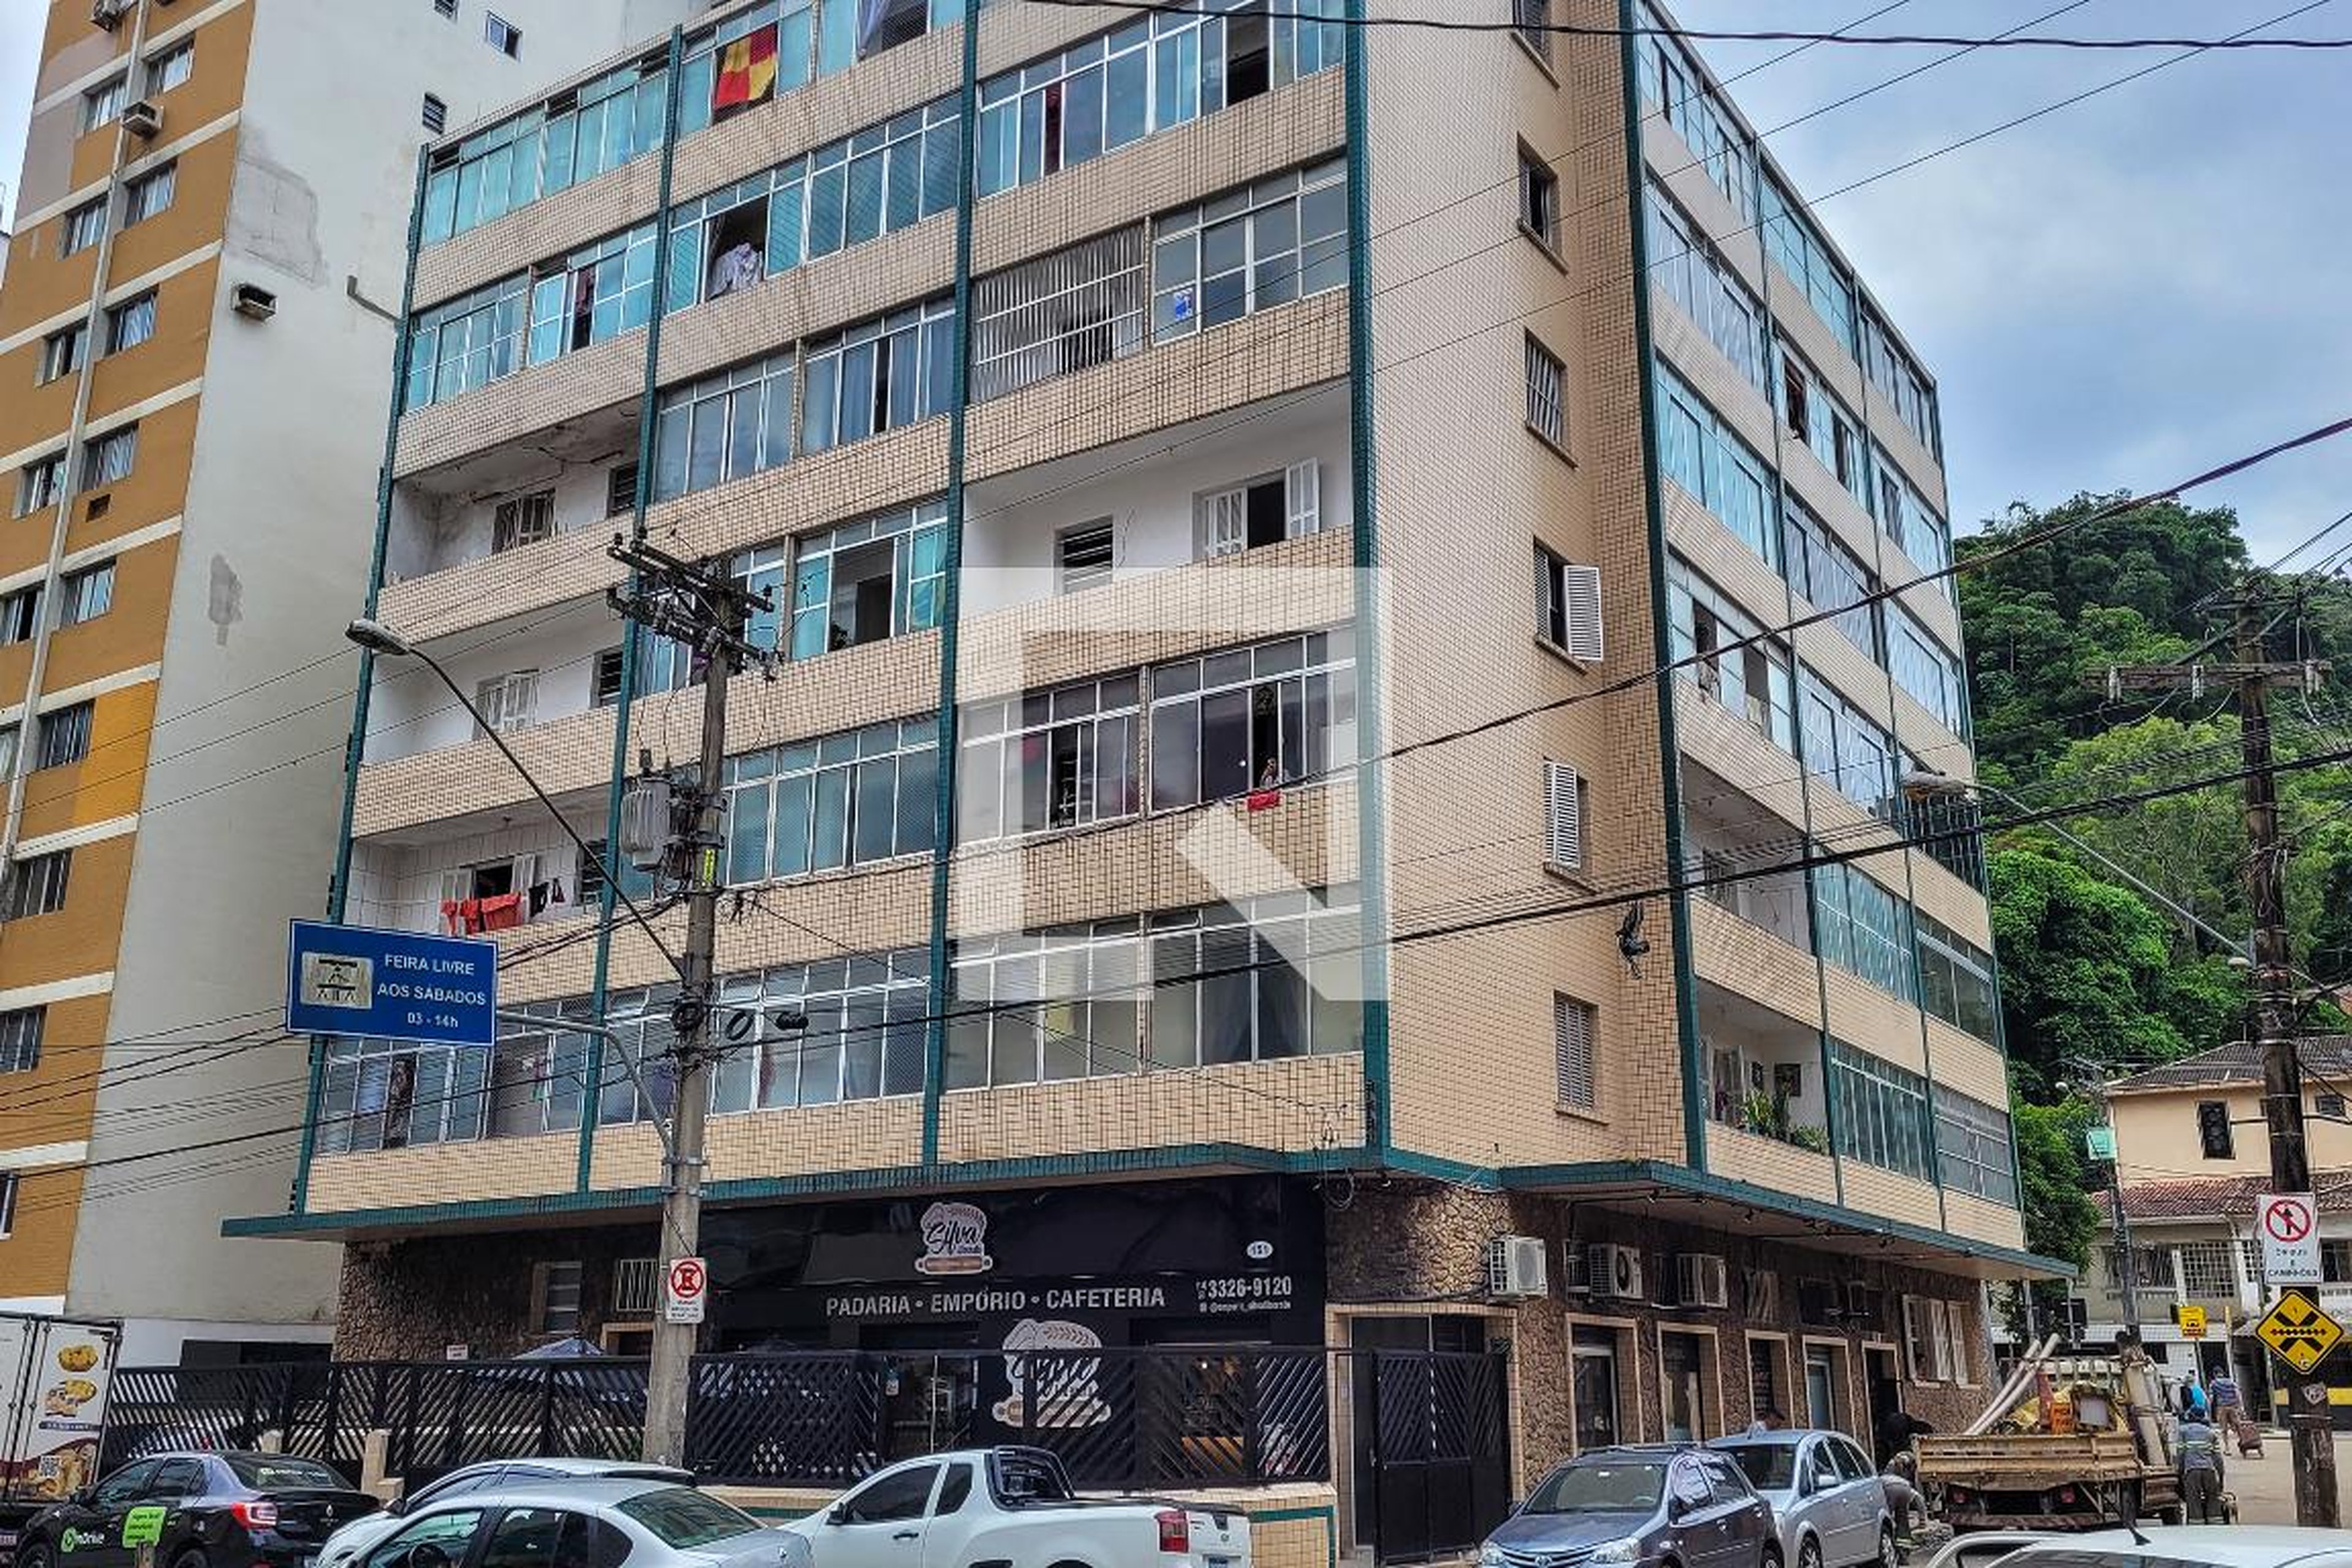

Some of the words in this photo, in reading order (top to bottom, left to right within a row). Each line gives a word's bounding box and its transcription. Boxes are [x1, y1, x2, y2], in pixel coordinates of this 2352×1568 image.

[385, 953, 429, 970] FEIRA
[432, 959, 475, 976] LIVRE
[377, 982, 410, 998] AOS
[407, 1012, 423, 1025] 03
[927, 1220, 979, 1256] Silva
[1208, 1275, 1292, 1298] 3326-9120
[827, 1295, 910, 1316] PADARIA
[930, 1285, 1026, 1313] EMPÓRIO
[1046, 1288, 1164, 1310] CAFETERIA
